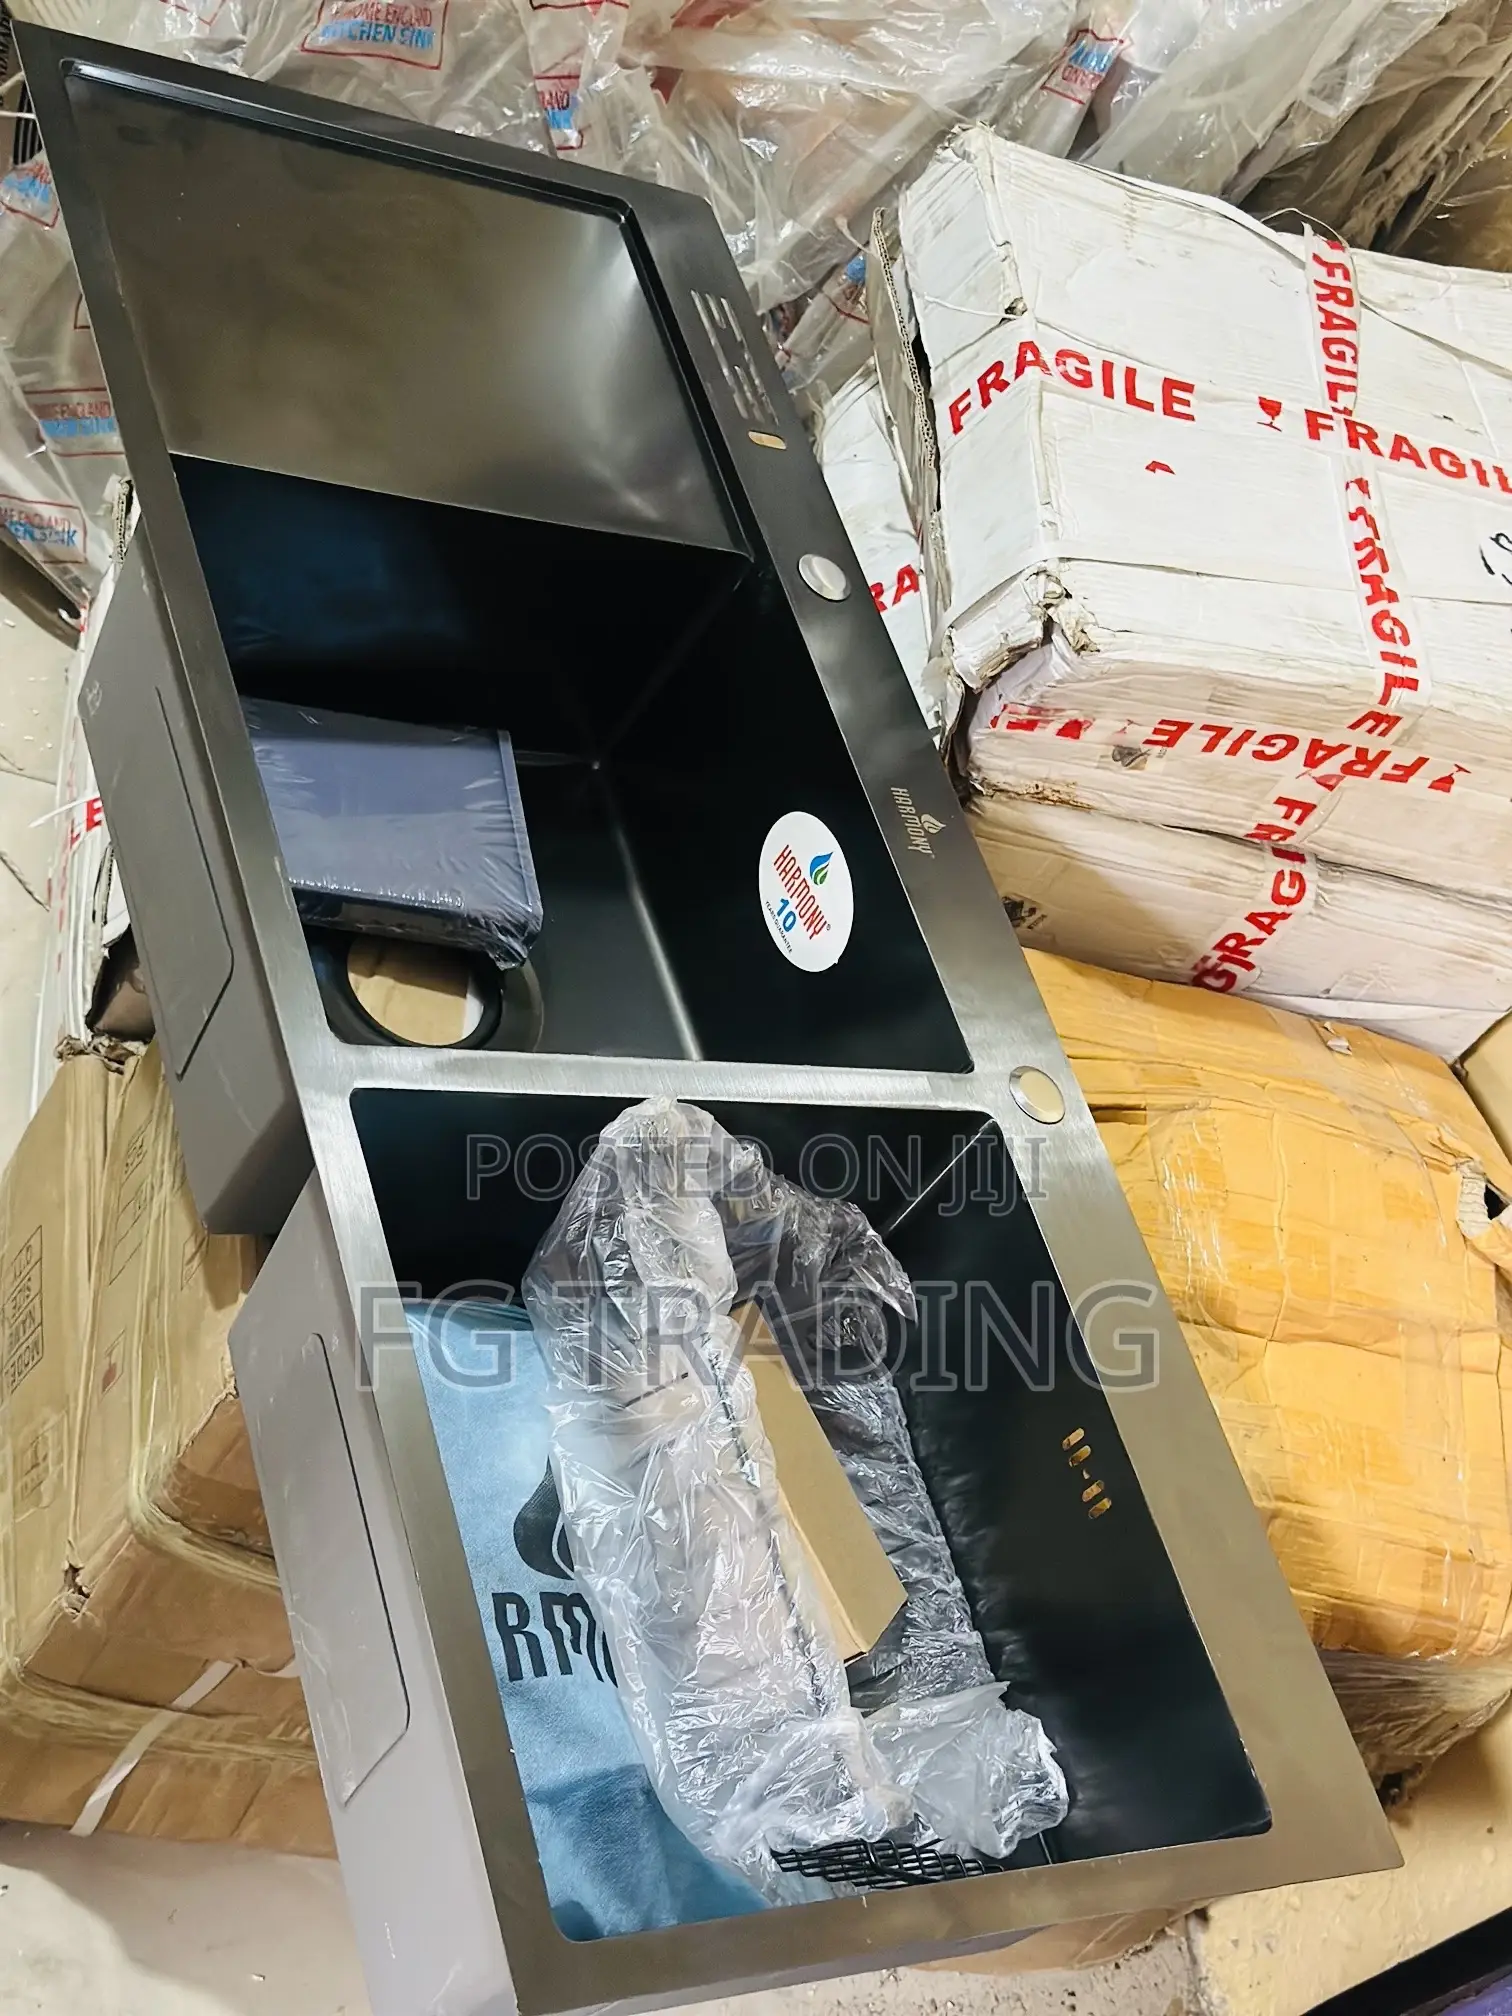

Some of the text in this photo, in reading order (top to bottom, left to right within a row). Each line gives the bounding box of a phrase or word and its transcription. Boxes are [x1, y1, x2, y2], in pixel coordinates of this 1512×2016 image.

[948, 340, 1196, 436] FRAGILE
[1142, 719, 1430, 784] FRAGILE
[776, 897, 797, 933] 10
